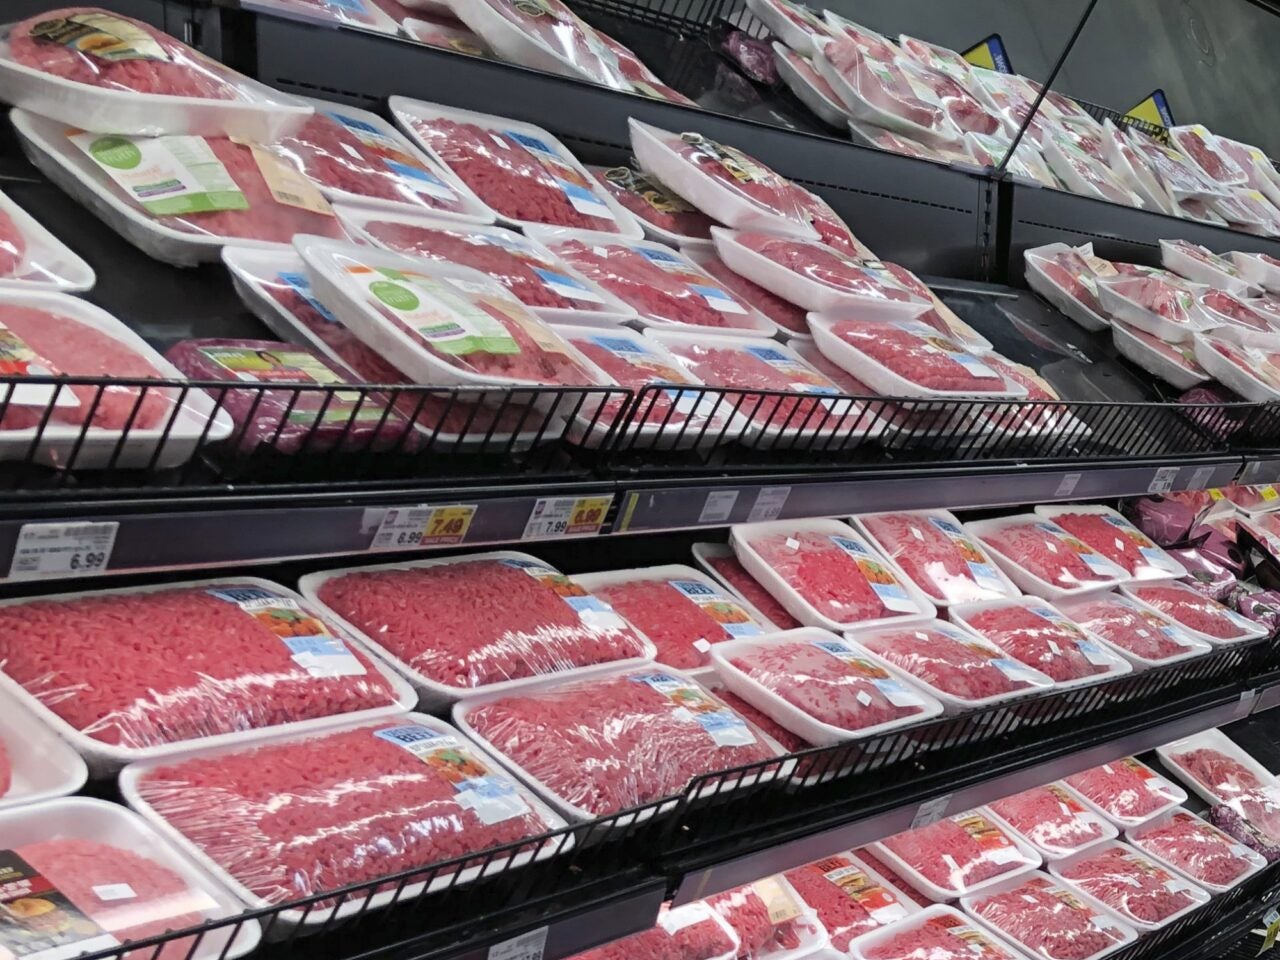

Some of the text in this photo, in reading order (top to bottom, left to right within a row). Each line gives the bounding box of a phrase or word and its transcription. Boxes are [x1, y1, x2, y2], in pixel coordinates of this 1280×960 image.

[432, 518, 464, 535] 7.49
[547, 521, 567, 532] 7.99
[70, 552, 105, 570] 6.99
[397, 731, 435, 743] BEEF
